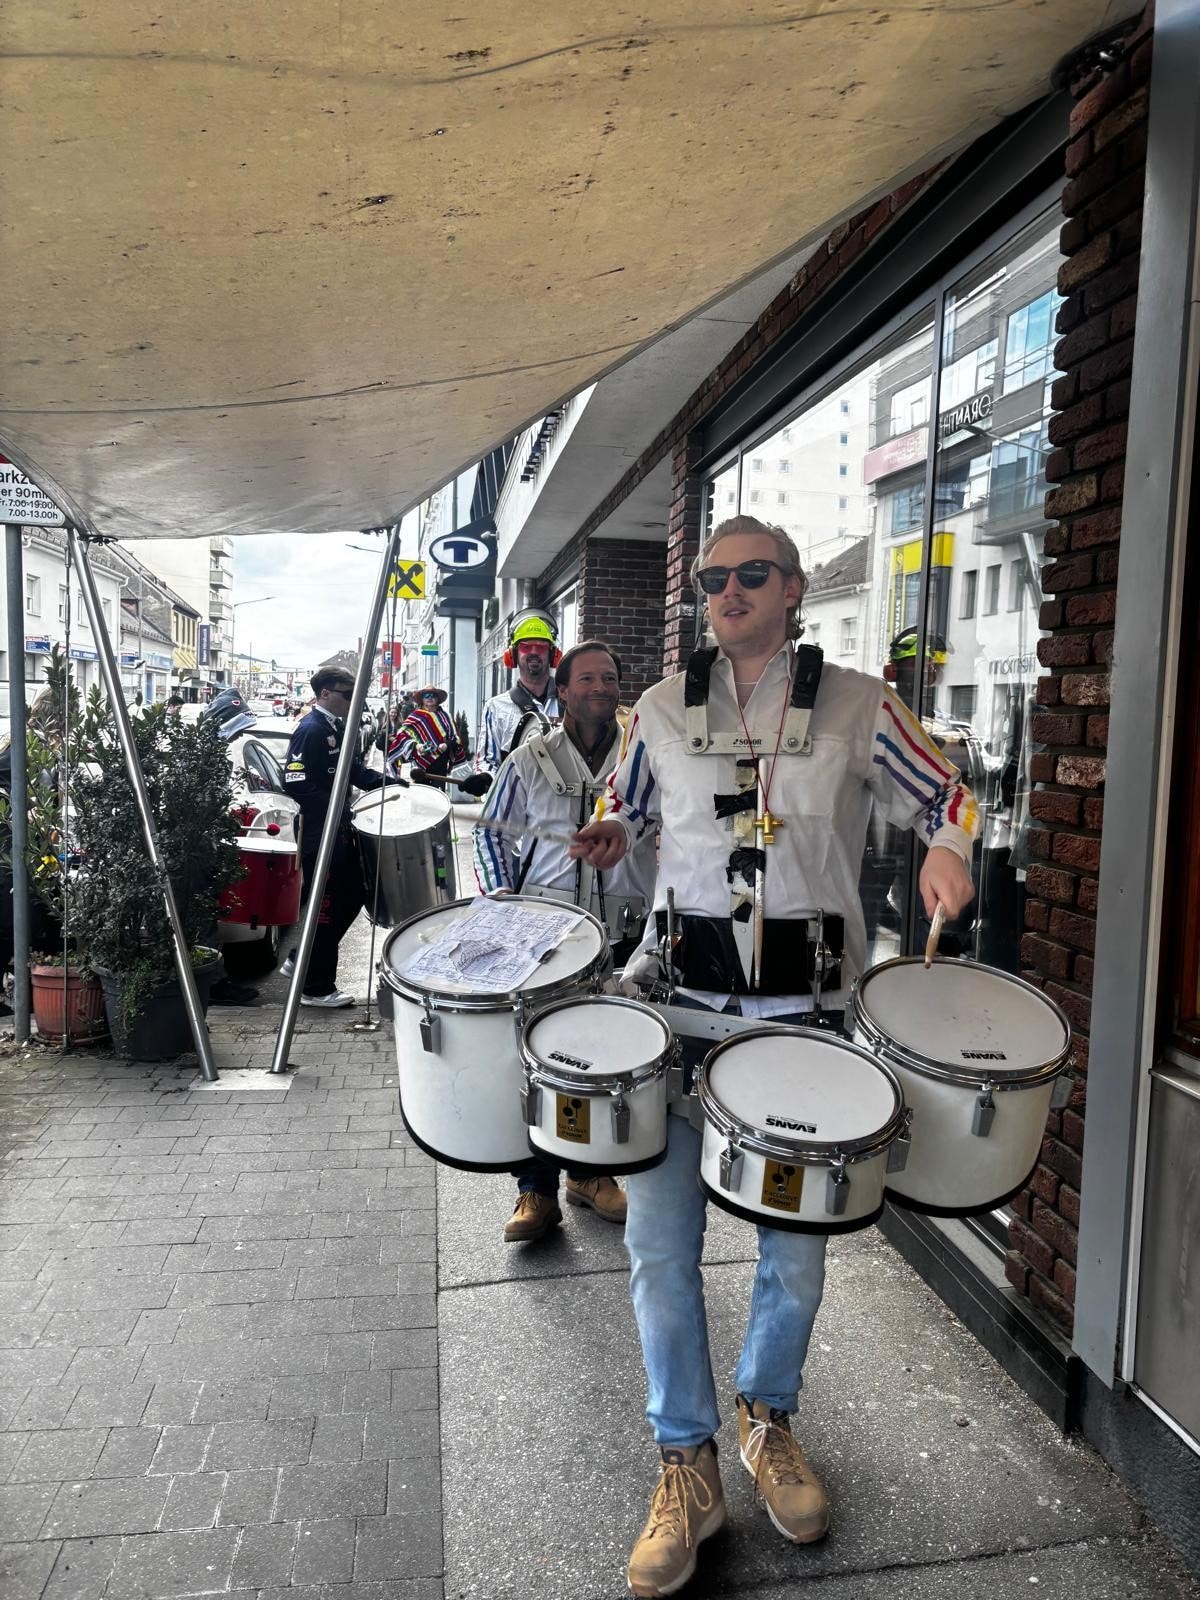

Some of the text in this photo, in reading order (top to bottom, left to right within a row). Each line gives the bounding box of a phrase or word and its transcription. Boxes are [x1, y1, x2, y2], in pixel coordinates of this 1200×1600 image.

[9, 509, 58, 519] 7.00-13.00h
[548, 1053, 590, 1071] EVANS
[961, 1053, 1007, 1061] EVANS
[765, 1118, 816, 1134] EVANS
